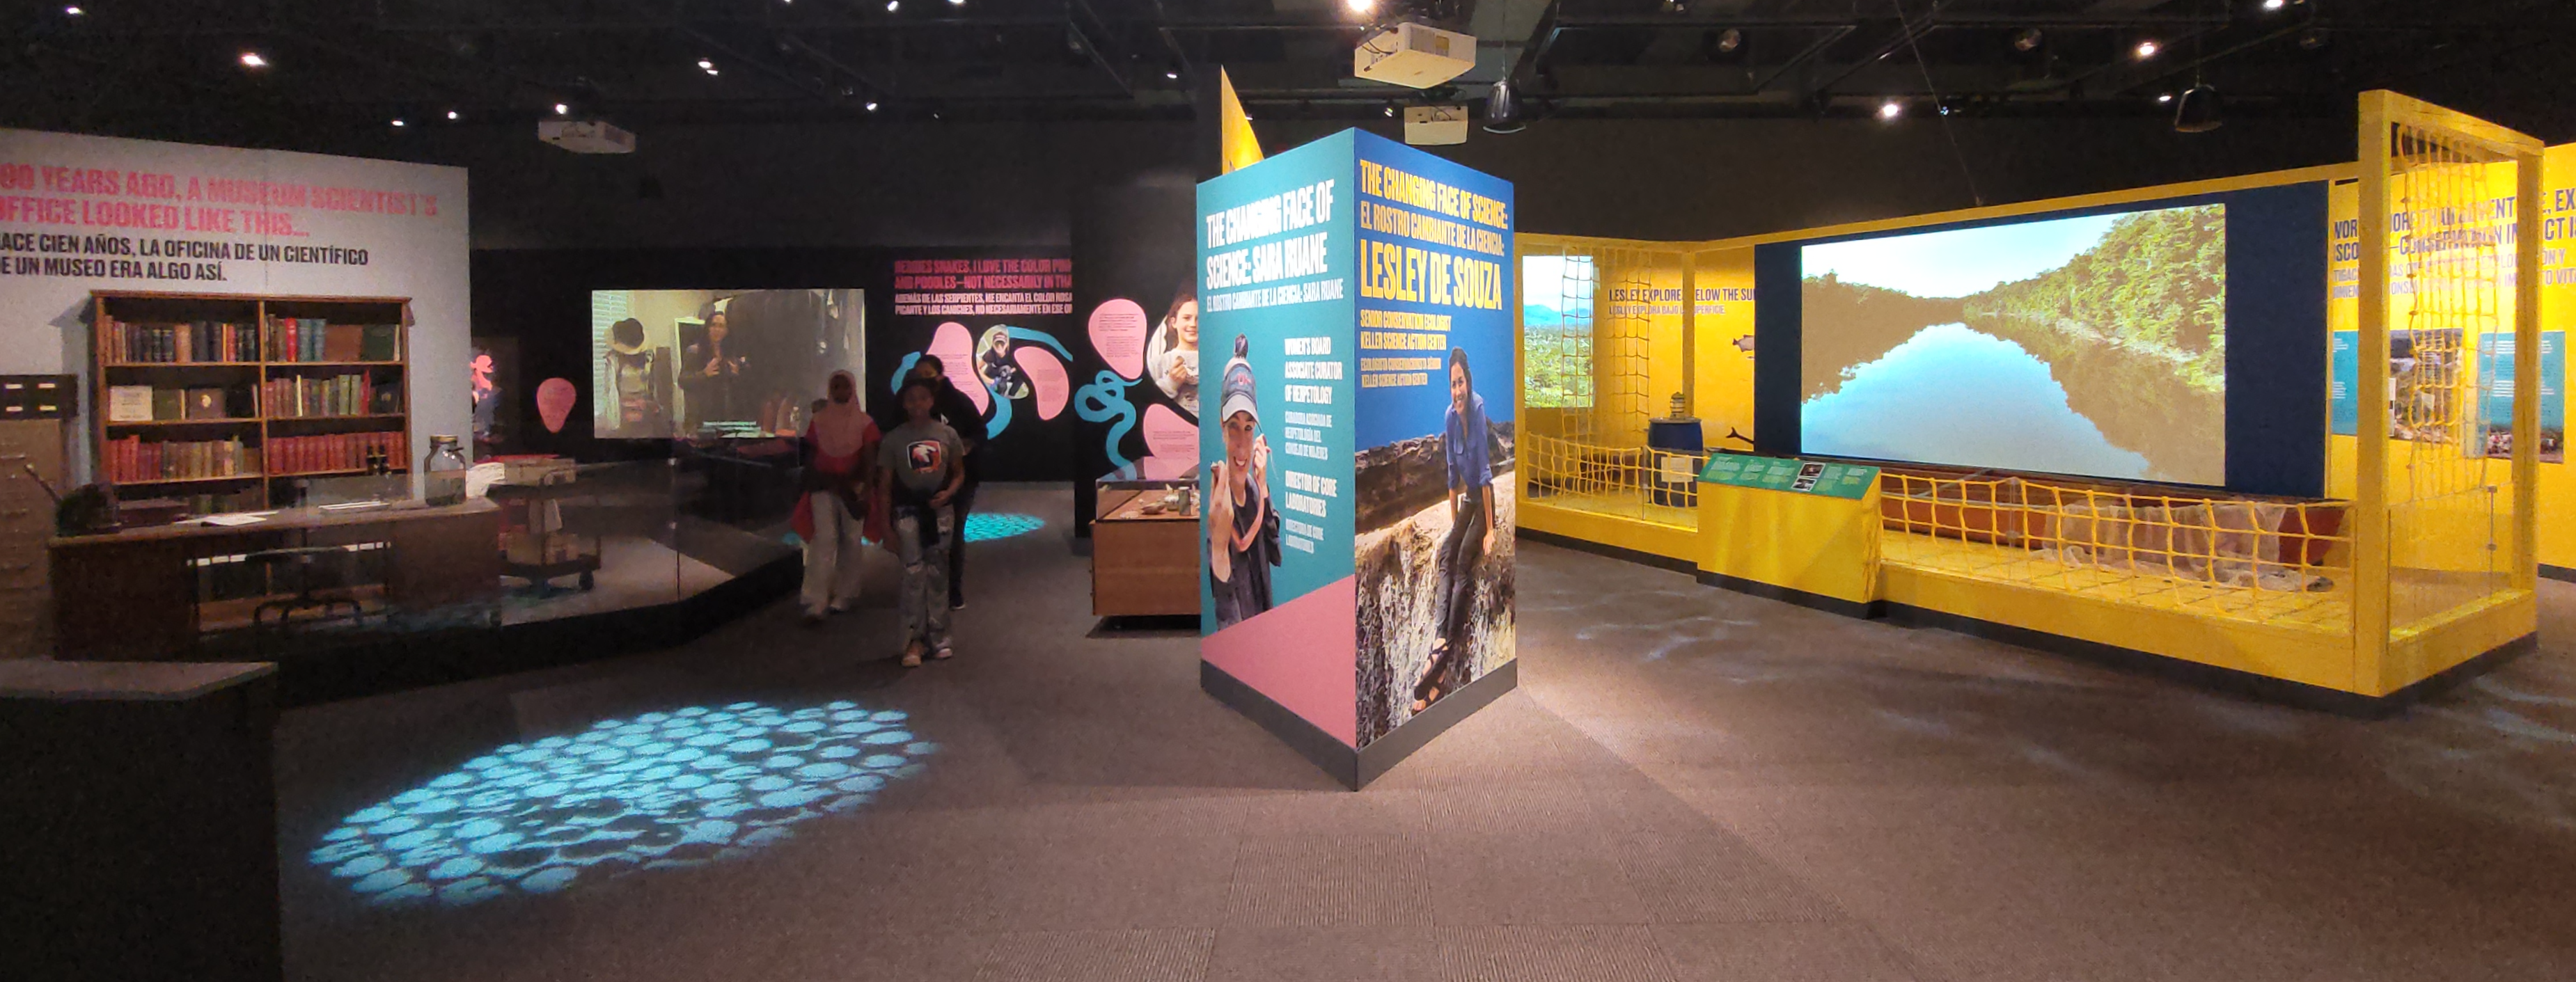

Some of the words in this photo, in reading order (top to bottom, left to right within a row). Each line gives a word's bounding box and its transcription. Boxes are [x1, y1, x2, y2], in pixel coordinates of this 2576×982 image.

[40, 166, 120, 196] YEARS
[127, 171, 181, 200] AGO,
[187, 176, 201, 200] A
[207, 177, 306, 207] MUSEUM
[1360, 159, 1383, 197] THE
[1383, 166, 1436, 211] CHANGING
[1437, 182, 1459, 217] FACE
[1460, 189, 1471, 220] OF
[1472, 193, 1508, 230] SCIENCE:
[82, 199, 179, 229] LOOKED
[184, 206, 237, 233] LIKE
[1207, 211, 1225, 249] THE
[1226, 194, 1282, 244] CHANGING
[1283, 184, 1314, 231] FACE
[1316, 179, 1335, 223] OF
[1360, 200, 1372, 230] EL
[1374, 203, 1410, 237] ROSTRO
[1411, 212, 1456, 246] CAMBIANTE
[1456, 223, 1466, 249] DE
[1467, 226, 1476, 251] LA
[1477, 228, 1505, 257] CIENCIA:
[40, 234, 79, 253] CIEN
[84, 233, 136, 258] AÑOS,
[140, 239, 159, 257] LA
[164, 239, 230, 260] OFICINA
[235, 243, 256, 260] DE
[258, 244, 280, 262] UN
[284, 244, 369, 266] CIENTÍFICO
[1207, 248, 1251, 290] SCIENCE:
[1252, 241, 1284, 283] SARA
[1285, 232, 1328, 278] RUANE
[15, 258, 40, 276] UN
[44, 258, 105, 277] MUSEO
[110, 260, 143, 278] ERA
[146, 261, 191, 280] ALGO
[195, 260, 228, 280] ASÍ.
[977, 259, 1000, 274] LOVE
[1003, 259, 1019, 273] THE
[1021, 259, 1051, 273] COLOR
[1360, 239, 1427, 303] LESLEY
[1430, 251, 1452, 306] DE
[1453, 255, 1502, 310] SOUZA
[1262, 288, 1269, 307] DE
[1270, 287, 1277, 306] LA
[1303, 281, 1320, 303] SARA
[1321, 278, 1343, 301] RUANE
[1609, 289, 1640, 301] LESLEY
[1642, 288, 1683, 301] EXPLORE
[1695, 288, 1720, 301] ELOW
[1722, 288, 1739, 301] THE
[1360, 309, 1383, 328] SENIOR
[1383, 310, 1424, 330] CONSERVATION
[1424, 313, 1452, 331] ECOLOGIST
[1285, 337, 1310, 356] WOMEN'S
[1311, 337, 1331, 355] BOARD
[1360, 331, 1383, 349] KELLER
[1383, 332, 1407, 350] SCIENCE
[1407, 333, 1427, 351] ACTION
[1427, 333, 1446, 351] CENTER
[1285, 361, 1314, 379] ASSOCIATE
[1314, 361, 1342, 380] CURATOR
[1285, 384, 1292, 402] OF
[1292, 385, 1332, 404] HERPETOLOGY
[1285, 470, 1312, 492] DIRECTOR
[1312, 475, 1320, 493] OF
[1321, 477, 1337, 498] CORE
[1285, 491, 1326, 518] LABORATORIES
